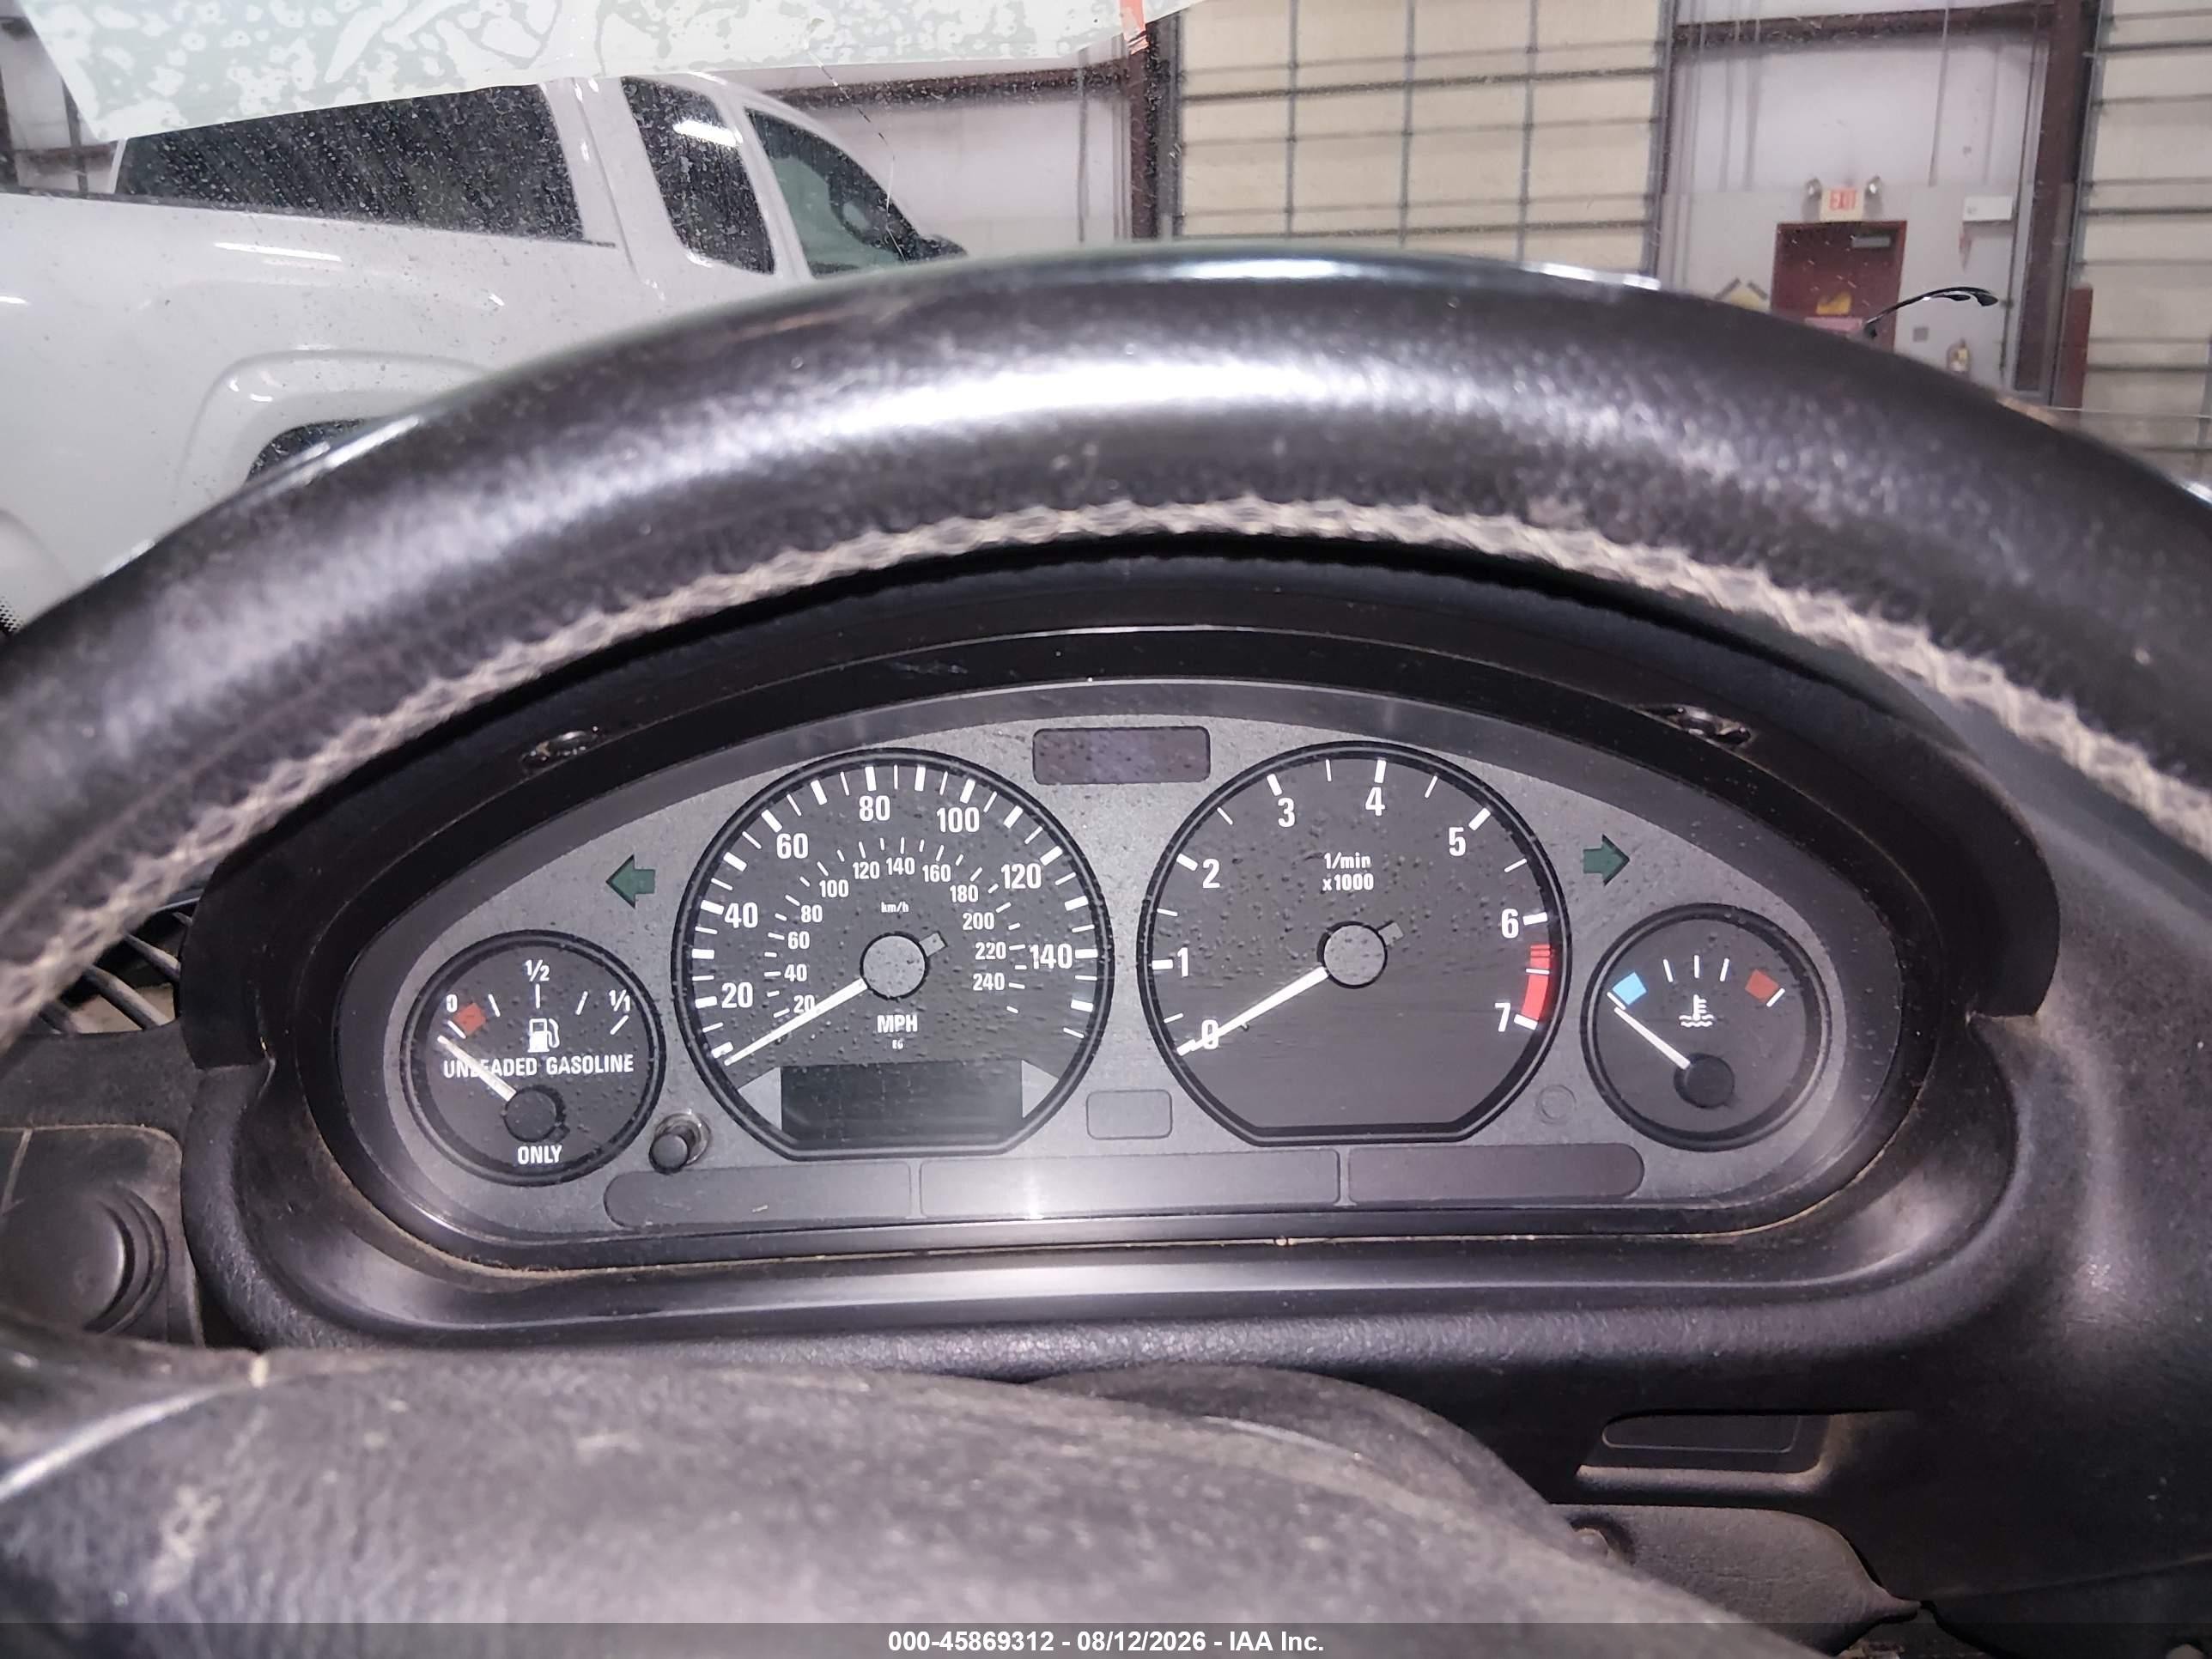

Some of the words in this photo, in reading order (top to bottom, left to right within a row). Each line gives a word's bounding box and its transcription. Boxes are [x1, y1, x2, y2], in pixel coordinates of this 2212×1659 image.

[1830, 189, 1856, 211] EXIT
[859, 795, 890, 821] 80
[1365, 787, 1384, 816] 4
[937, 807, 980, 832] 100
[1278, 798, 1295, 827] 3
[776, 834, 808, 859] 60
[1449, 828, 1465, 856] 5
[853, 860, 879, 879] 120
[886, 858, 915, 875] 140
[1324, 852, 1371, 869] 1/min
[922, 865, 951, 883] 160
[1001, 864, 1041, 889] 120
[1202, 859, 1220, 889] 2
[1322, 873, 1373, 890] x1000
[819, 880, 848, 897] 100
[950, 885, 978, 902] 180
[725, 902, 757, 927] 40
[800, 906, 823, 922] 80
[881, 902, 909, 914] km/h
[963, 912, 994, 929] 200
[1501, 909, 1518, 938] 6
[787, 932, 810, 949] 60
[975, 942, 1006, 959] 220
[1030, 944, 1073, 969] 140
[1177, 947, 1188, 976] 1
[784, 964, 807, 981] 40
[972, 974, 1005, 991] 240
[447, 994, 458, 1012] 0
[721, 982, 752, 1007] 20
[793, 995, 815, 1014] 20
[877, 1014, 918, 1033] MPH
[1495, 1003, 1511, 1032] 7
[1201, 1019, 1219, 1049] 0
[546, 1054, 634, 1074] GASOLINE
[518, 1146, 562, 1164] ONLY
